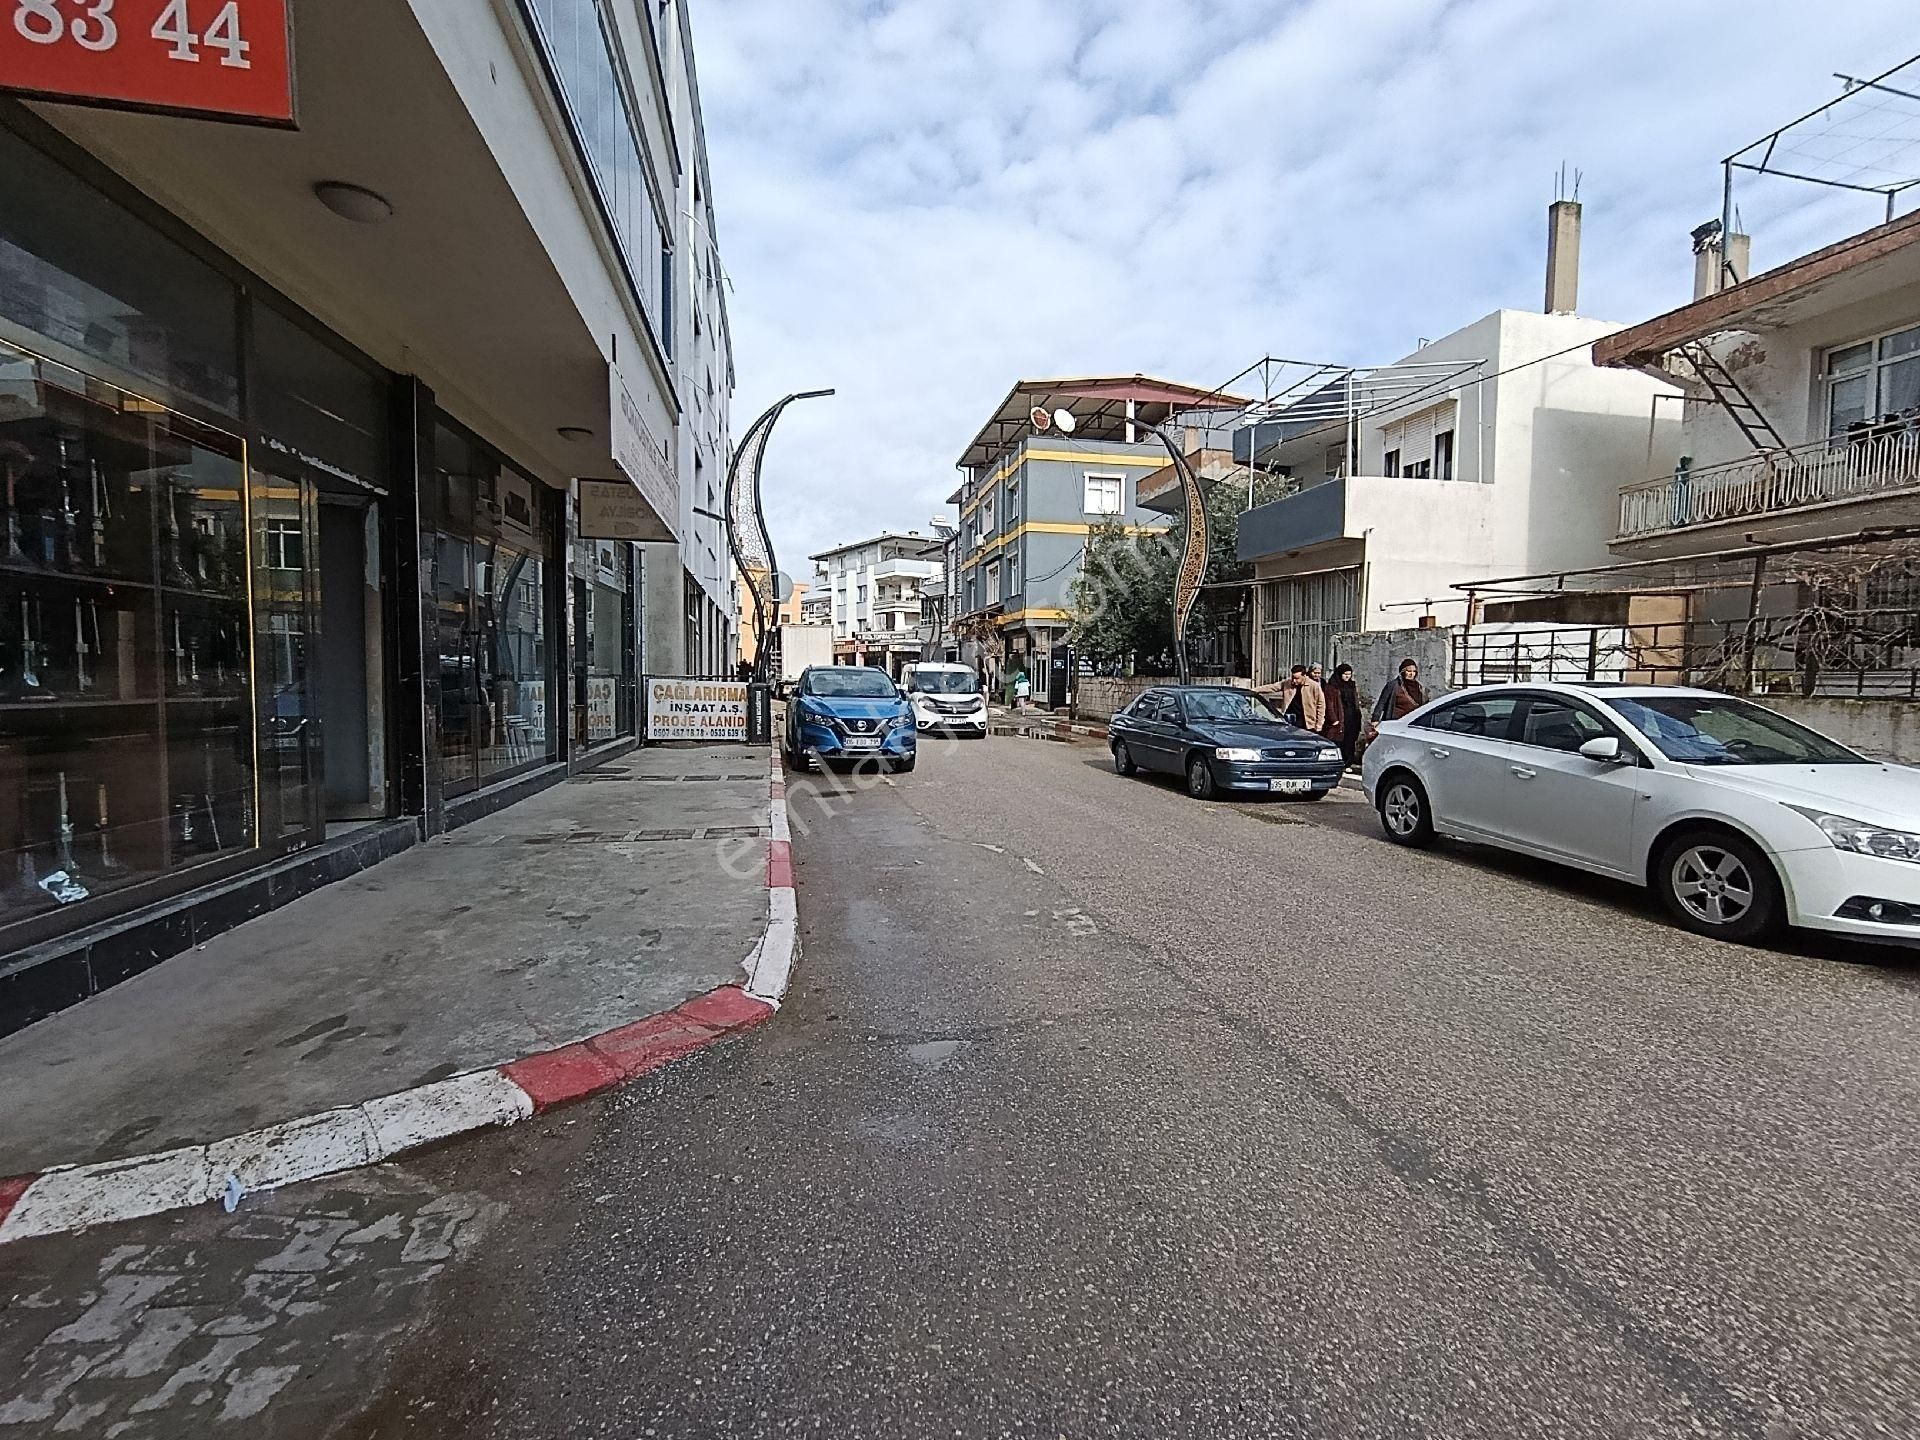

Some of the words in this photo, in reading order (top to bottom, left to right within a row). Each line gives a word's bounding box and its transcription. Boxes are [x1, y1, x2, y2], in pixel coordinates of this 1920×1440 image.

[14, 0, 117, 50] 83
[151, 0, 250, 69] 44
[653, 682, 747, 703] ÇAĞLARIRMA
[670, 701, 715, 714] İNŞAAT
[720, 703, 743, 715] A.Ş.
[653, 715, 695, 727] PROJE
[711, 729, 724, 738] 0533
[727, 729, 738, 738] 639
